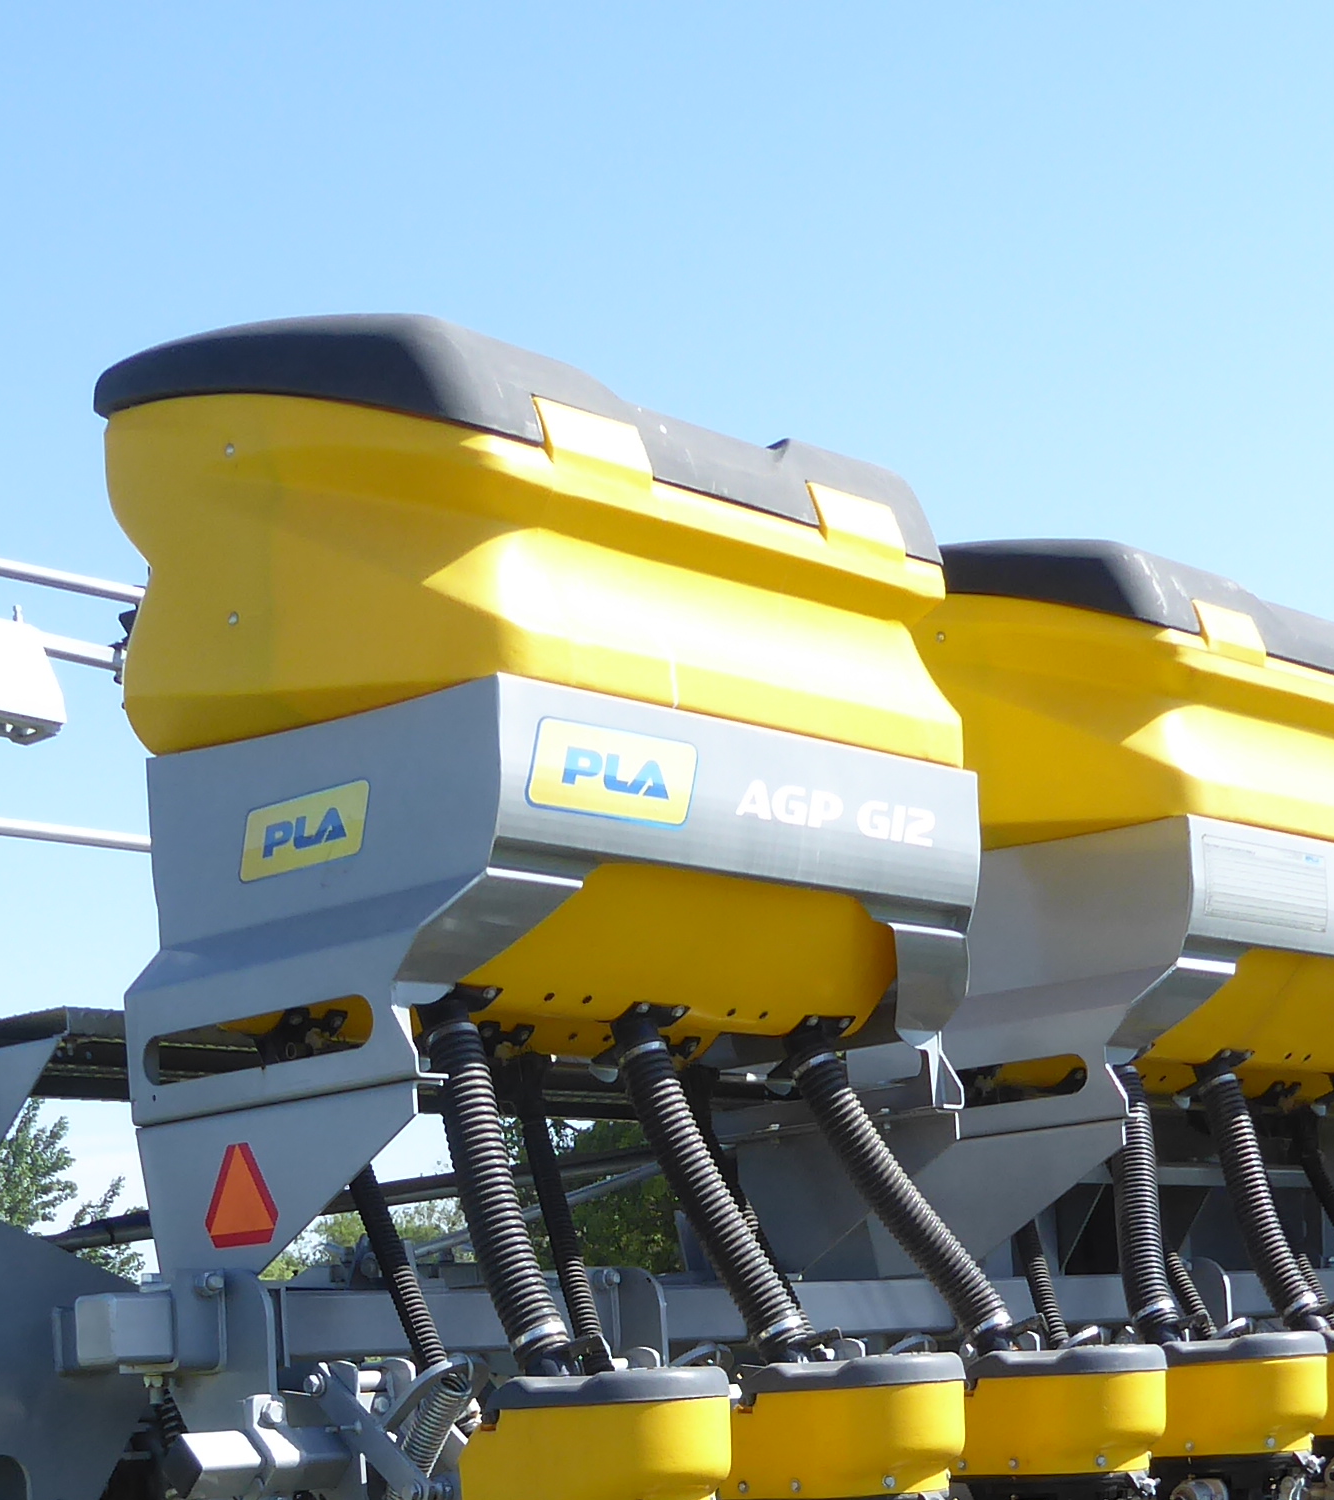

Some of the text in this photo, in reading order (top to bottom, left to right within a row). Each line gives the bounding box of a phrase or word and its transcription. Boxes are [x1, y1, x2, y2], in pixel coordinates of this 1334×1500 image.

[561, 745, 670, 801] PLA
[735, 779, 844, 829] AGP
[262, 807, 347, 859] PLA
